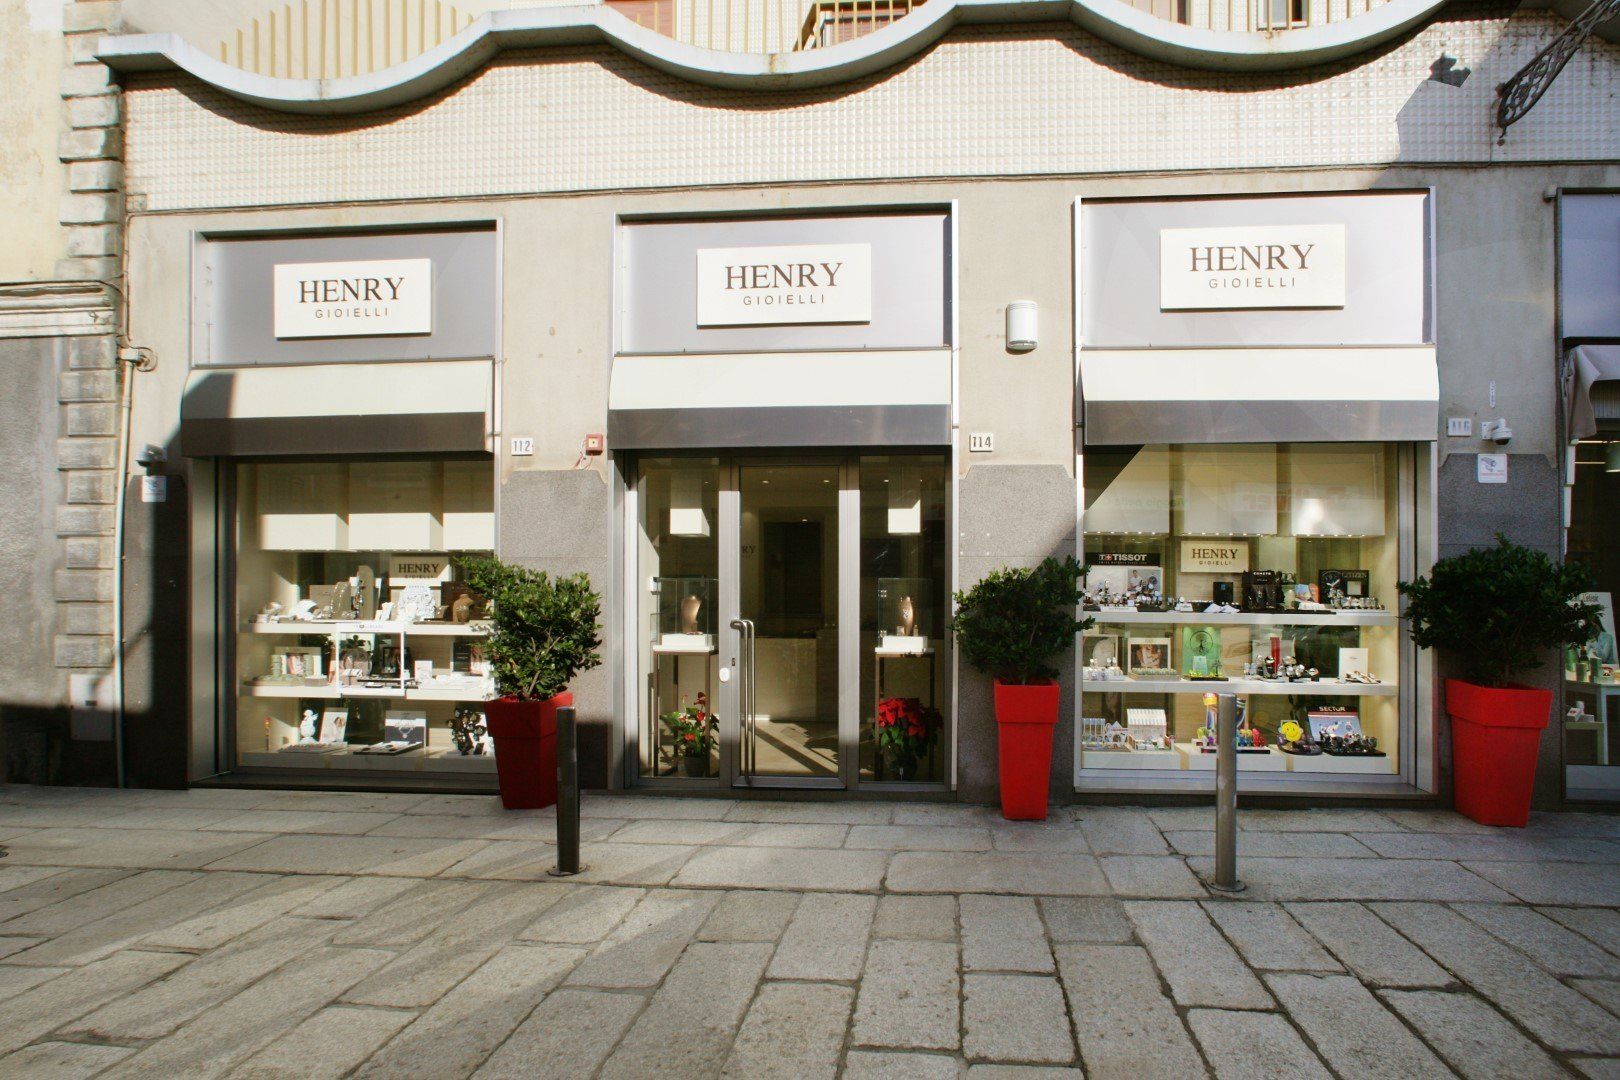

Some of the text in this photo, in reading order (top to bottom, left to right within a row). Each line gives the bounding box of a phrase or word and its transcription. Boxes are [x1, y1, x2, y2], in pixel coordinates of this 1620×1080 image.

[1189, 244, 1315, 272] HENRY
[724, 262, 843, 290] HENRY
[1208, 277, 1296, 289] GIOIELLI
[298, 277, 405, 304] HENRY
[743, 294, 825, 306] GIOIELLI
[315, 307, 389, 319] GIOIELLI
[513, 440, 531, 453] 112
[972, 435, 992, 448] 114
[1112, 553, 1148, 562] TISSOT
[1192, 548, 1239, 560] HENRY
[398, 563, 440, 574] HENRY
